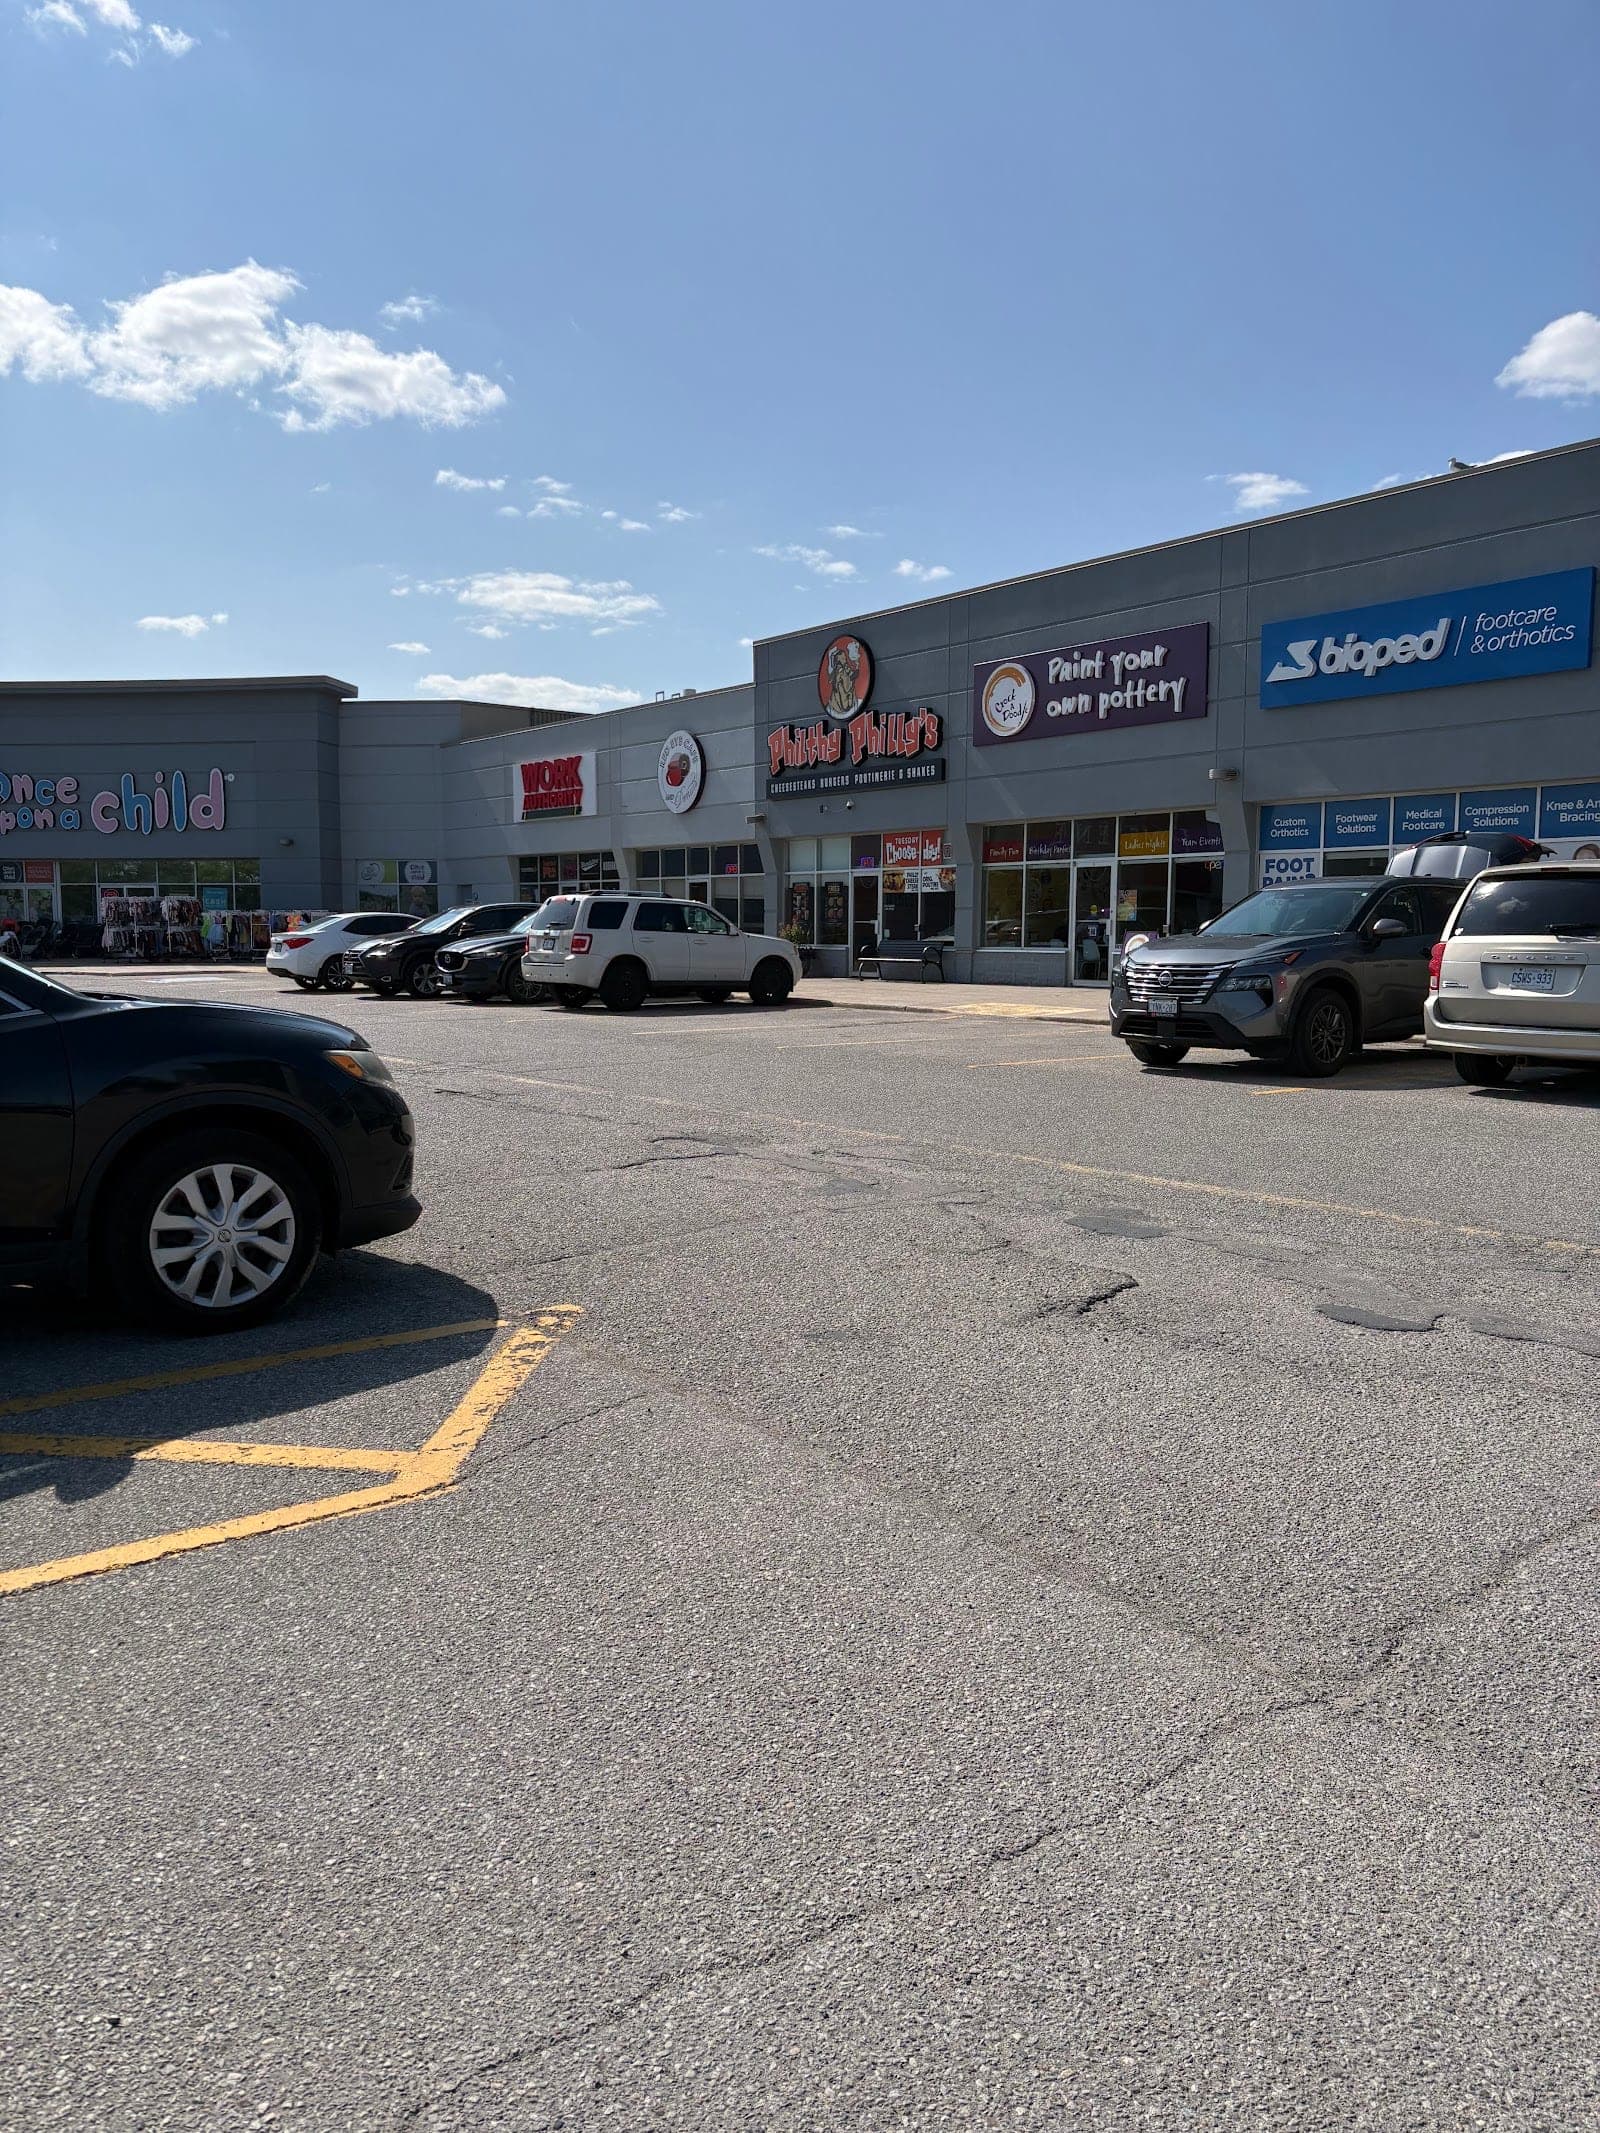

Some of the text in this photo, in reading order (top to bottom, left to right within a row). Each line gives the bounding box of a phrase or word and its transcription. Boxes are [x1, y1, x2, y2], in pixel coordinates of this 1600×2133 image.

[1475, 606, 1558, 633] footcare
[1319, 618, 1450, 677] bioped
[1470, 624, 1577, 654] & orthotics
[1048, 645, 1168, 686] Paint your
[995, 689, 1016, 713] Crock
[1047, 677, 1187, 720] own pottery
[1003, 701, 1028, 726] Doodle
[768, 708, 939, 776] Philthy Philly's
[521, 755, 583, 793] WORK
[770, 779, 815, 794] CHEESESTEAKS
[820, 775, 849, 789] BURGERS
[854, 770, 895, 785] POUTINERIE
[907, 765, 935, 778] SHAKES
[91, 767, 225, 835] child
[523, 788, 583, 810] AUTHORITY
[1464, 803, 1529, 817] Compression
[1546, 801, 1574, 811] Knee
[1576, 799, 1585, 809] &
[0, 807, 81, 835] pon a
[1274, 817, 1306, 828] Custom
[1335, 813, 1378, 824] Footwear
[1406, 808, 1442, 819] Medical
[1473, 816, 1519, 828] Solutions
[1270, 827, 1309, 838] Orthotics
[1336, 824, 1377, 834] Solutions
[1402, 820, 1446, 831] Footcare
[895, 836, 918, 845] TUESDAY
[1265, 857, 1315, 873] FOOT
